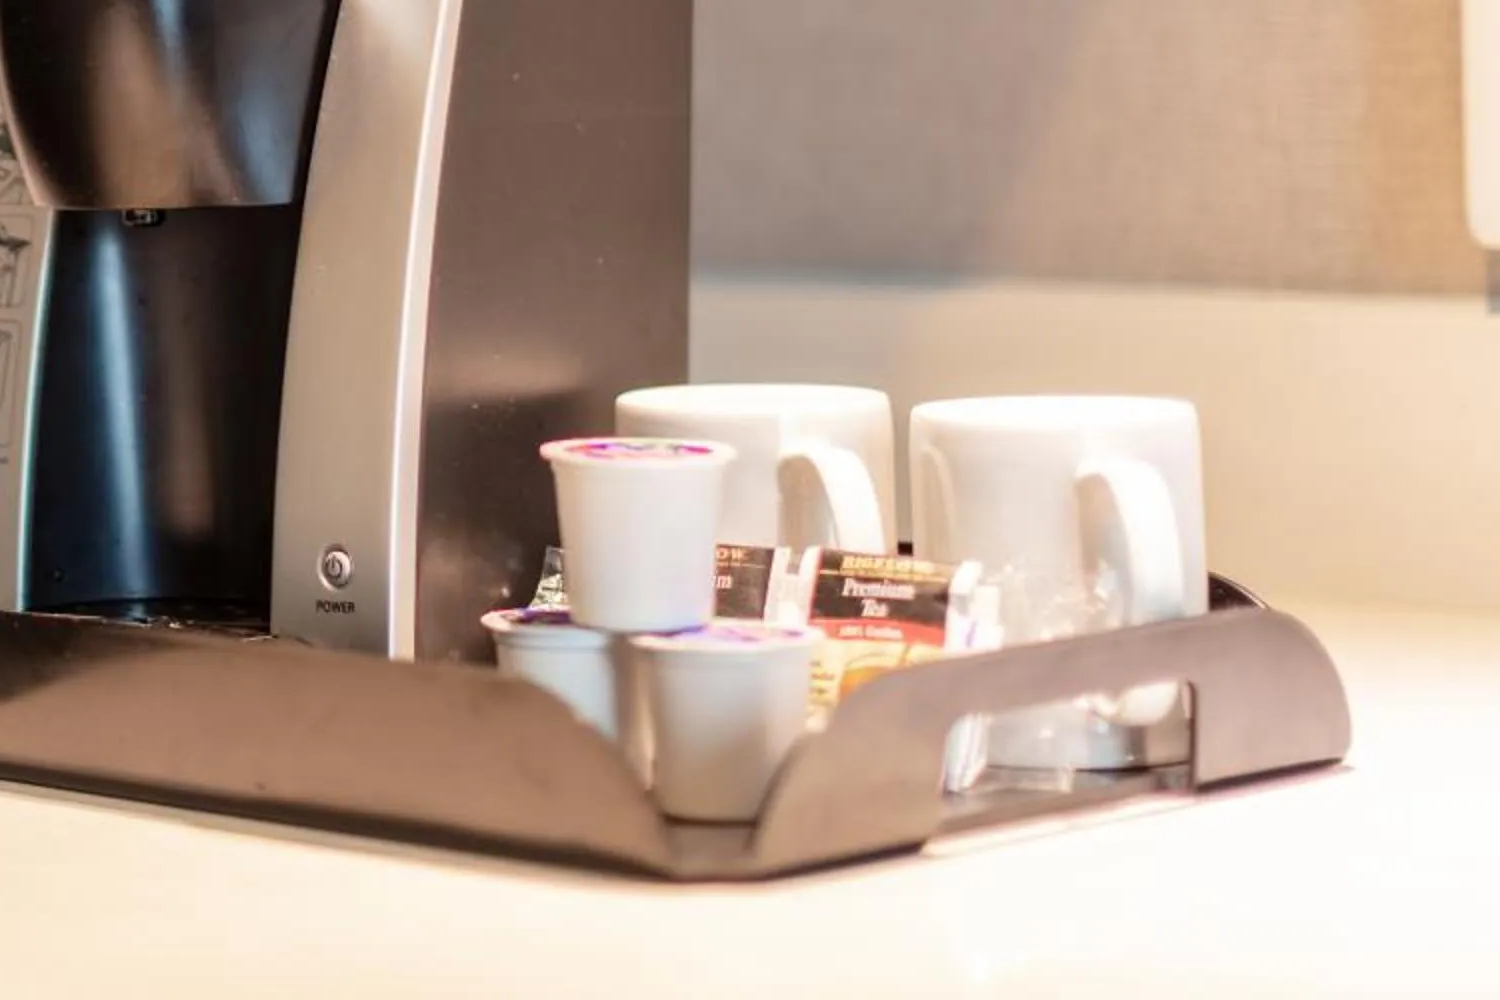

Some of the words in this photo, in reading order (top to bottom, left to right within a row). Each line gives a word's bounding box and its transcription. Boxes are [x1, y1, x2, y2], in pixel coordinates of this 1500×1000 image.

[841, 577, 917, 601] Premium
[315, 599, 356, 614] POWER
[860, 600, 889, 618] Tea
